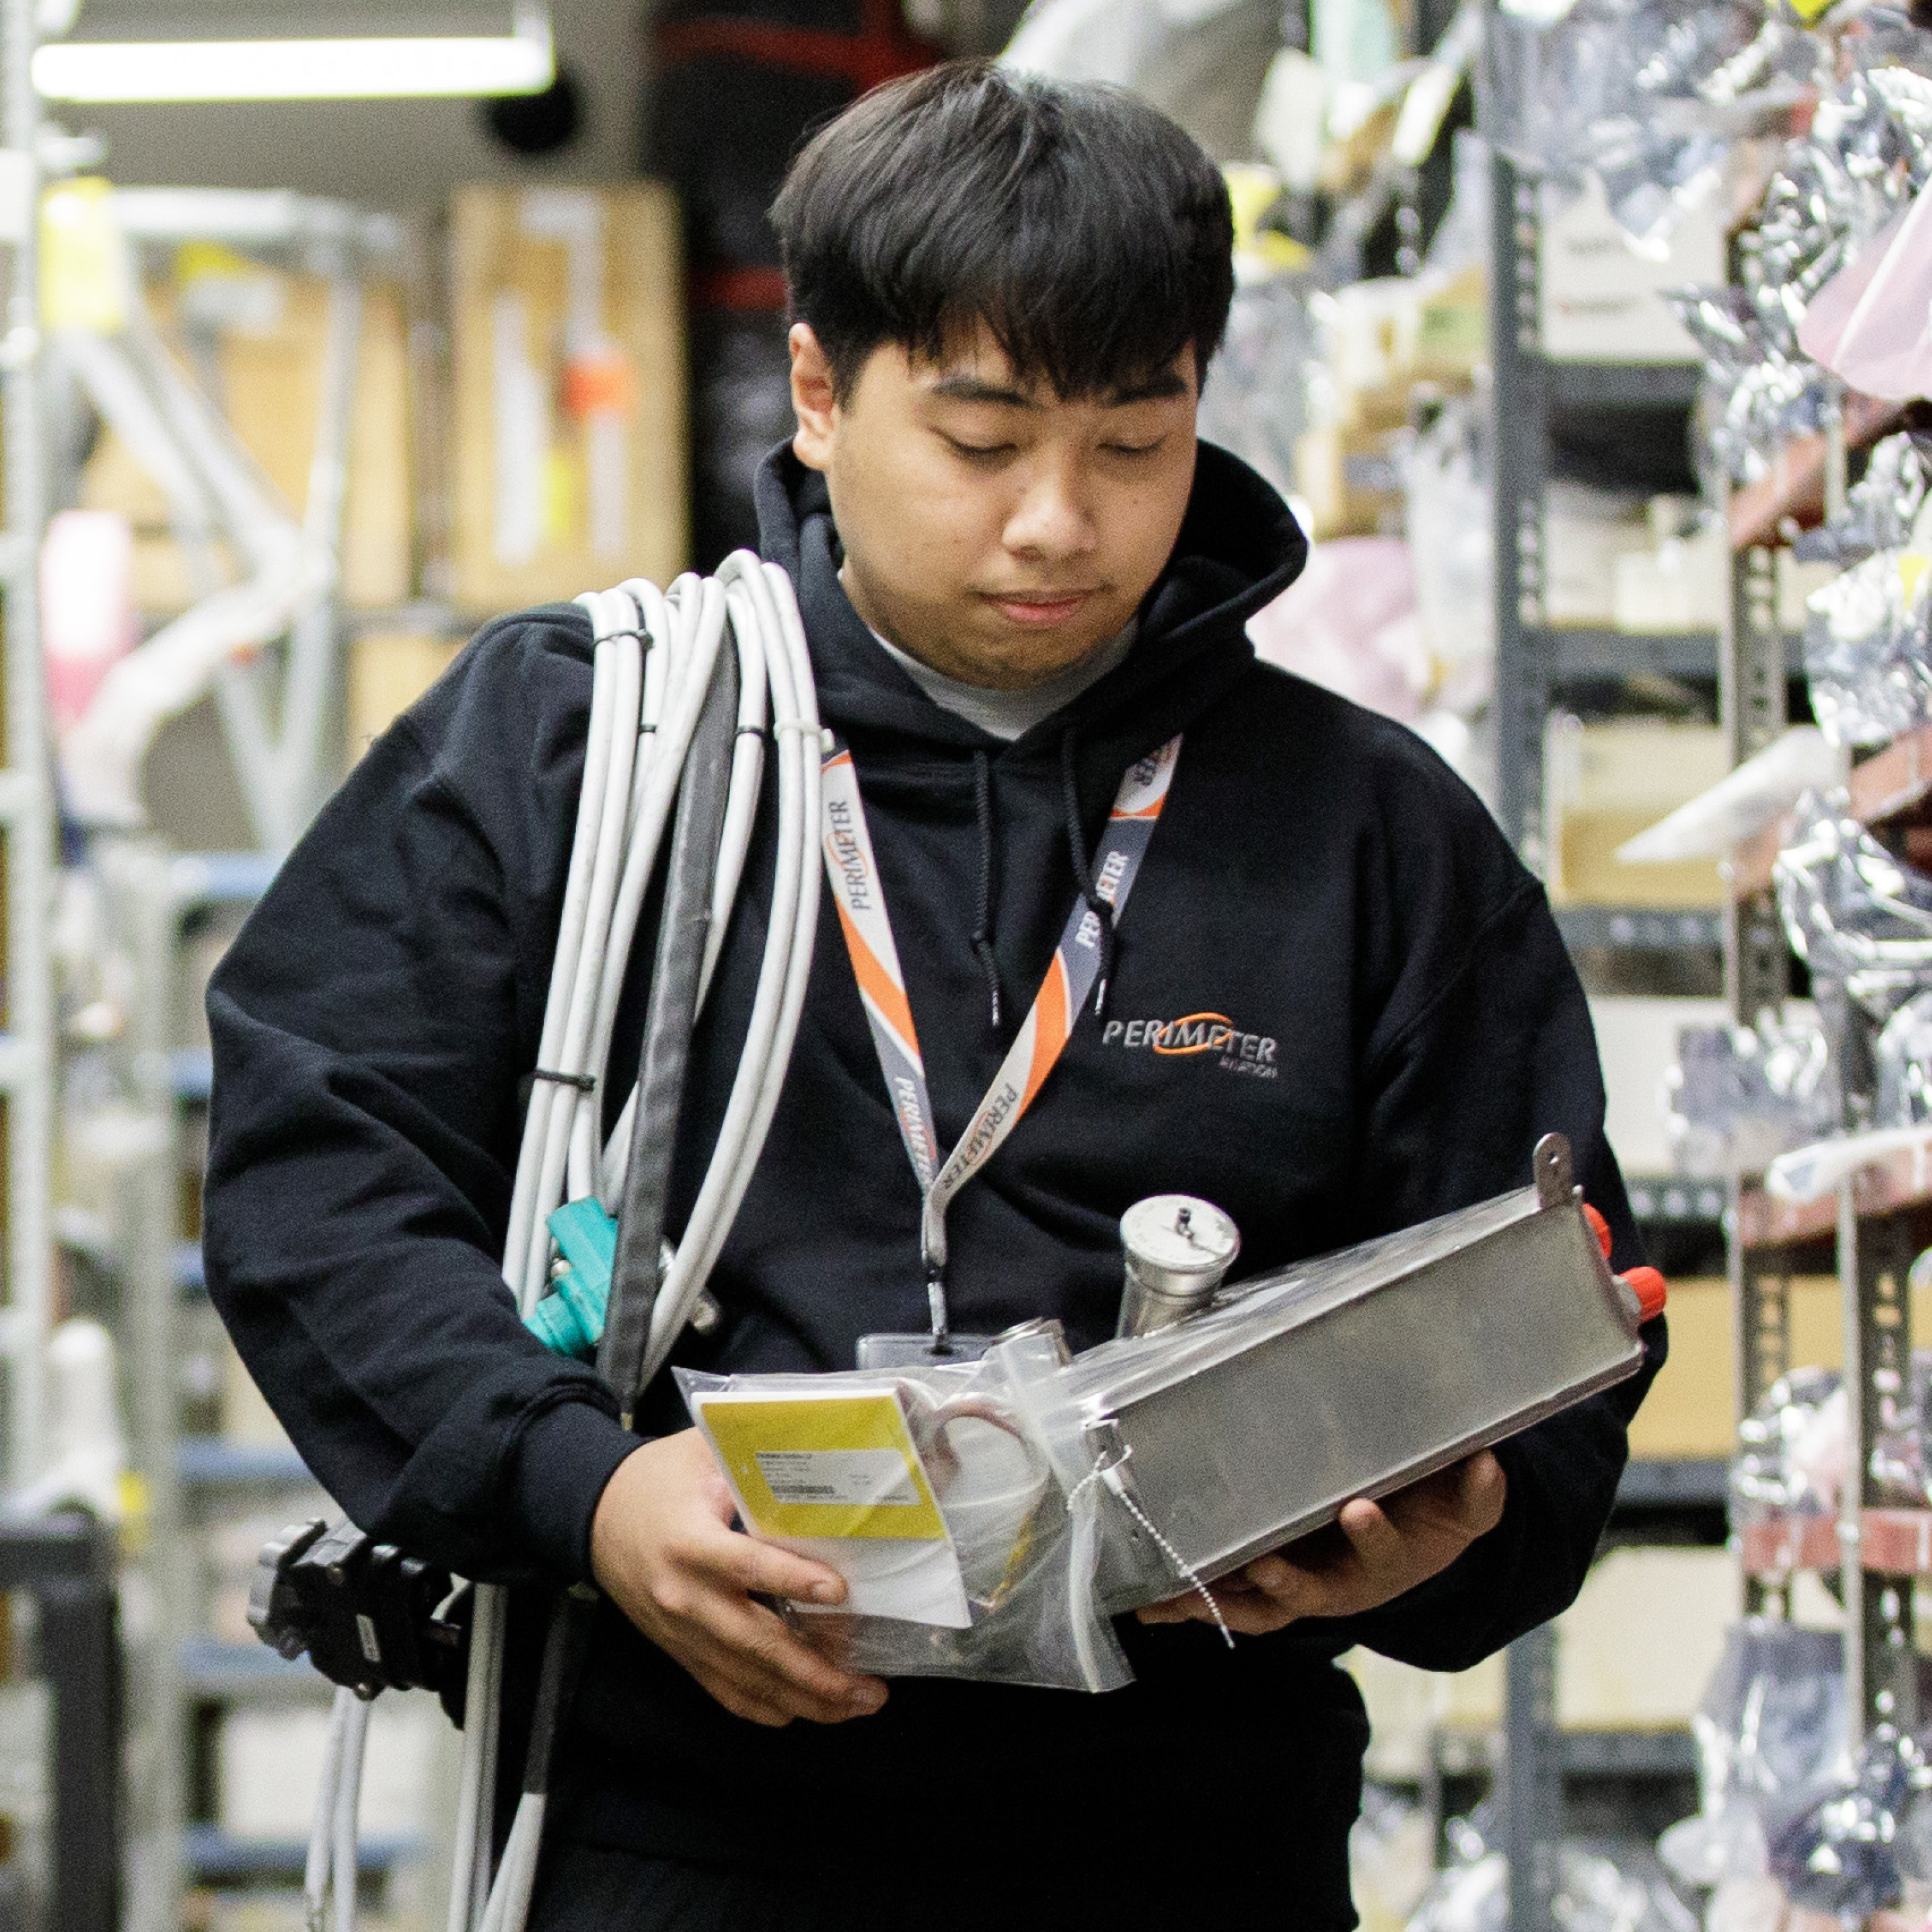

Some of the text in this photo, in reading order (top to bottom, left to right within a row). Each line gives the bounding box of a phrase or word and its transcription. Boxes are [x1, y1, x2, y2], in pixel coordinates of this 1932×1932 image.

[829, 800, 872, 910] PERIMETER
[1102, 1019, 1277, 1063] PERIMETER
[941, 1083, 1018, 1190] PERIMETER
